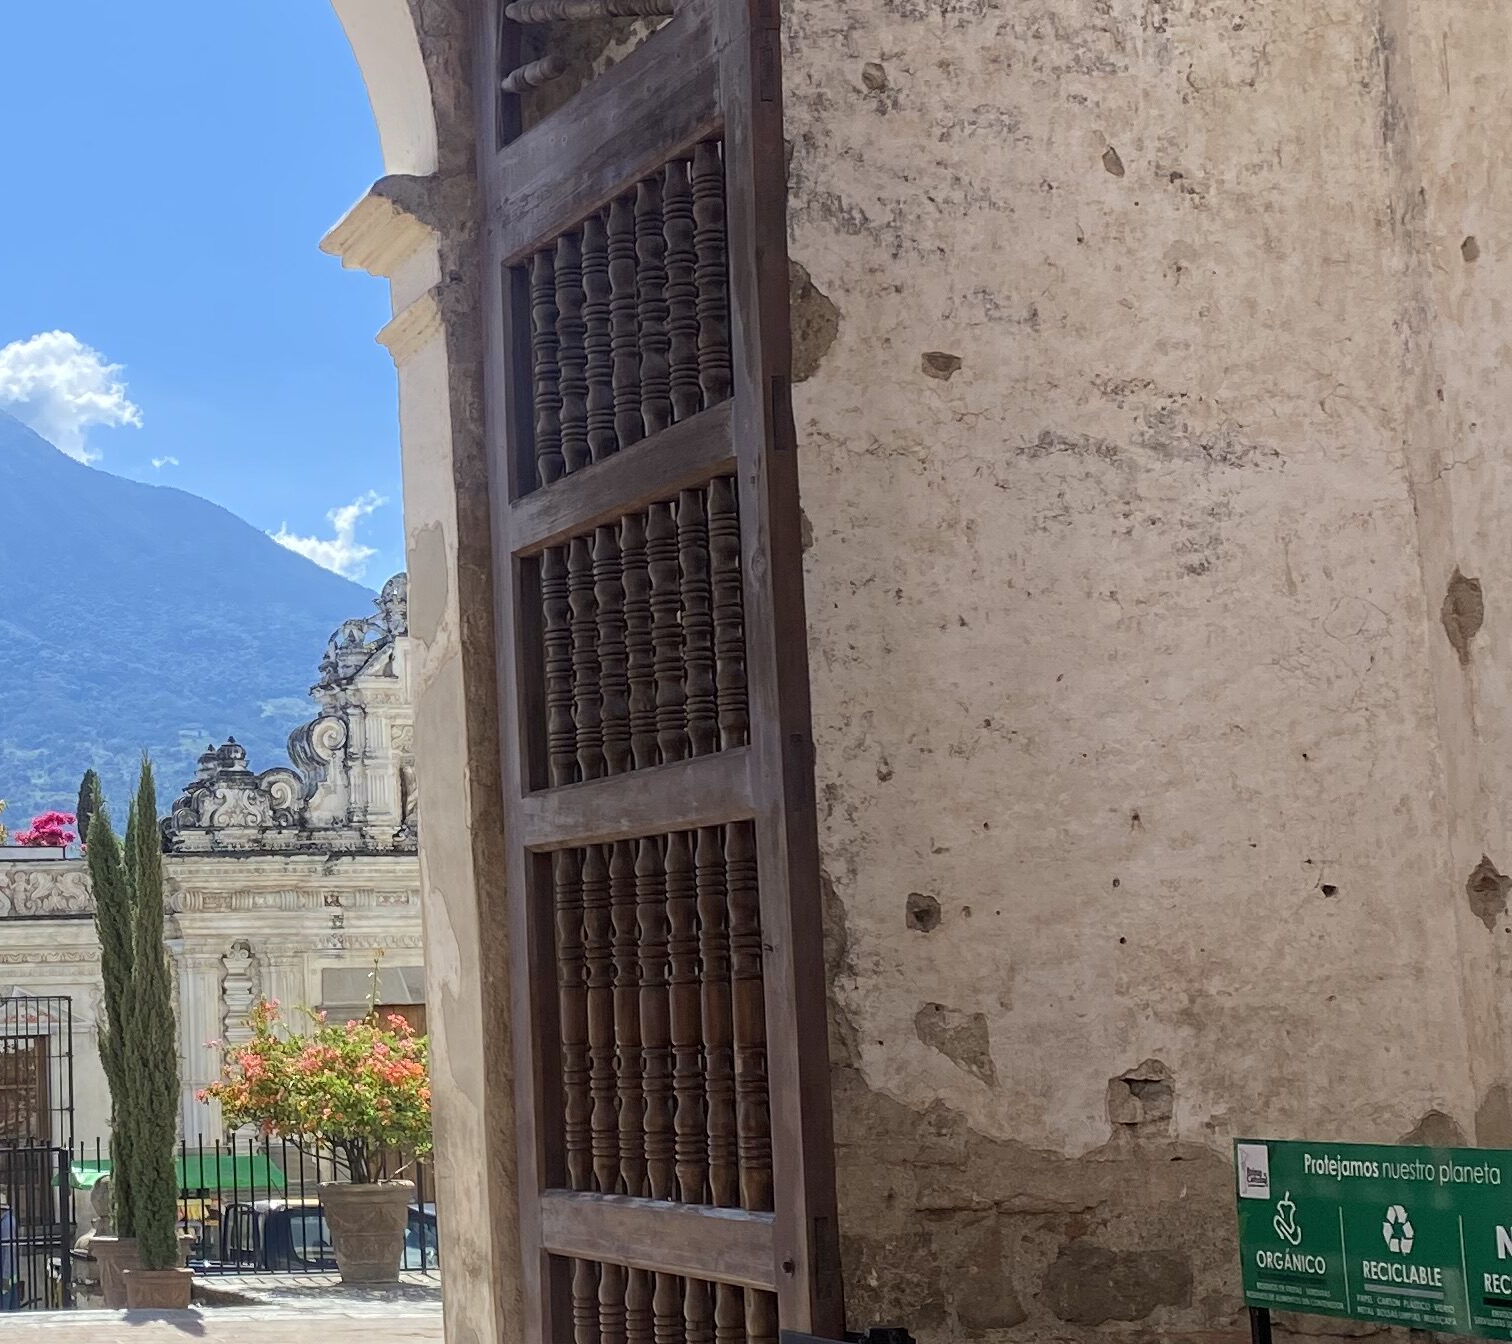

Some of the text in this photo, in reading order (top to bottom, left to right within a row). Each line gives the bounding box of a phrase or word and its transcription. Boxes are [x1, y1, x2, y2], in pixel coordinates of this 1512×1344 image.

[1304, 1154, 1501, 1186] Protejamos nuestro planeta
[1256, 1248, 1326, 1275] ORGÁNICO
[1362, 1260, 1442, 1286] RECICLABLE
